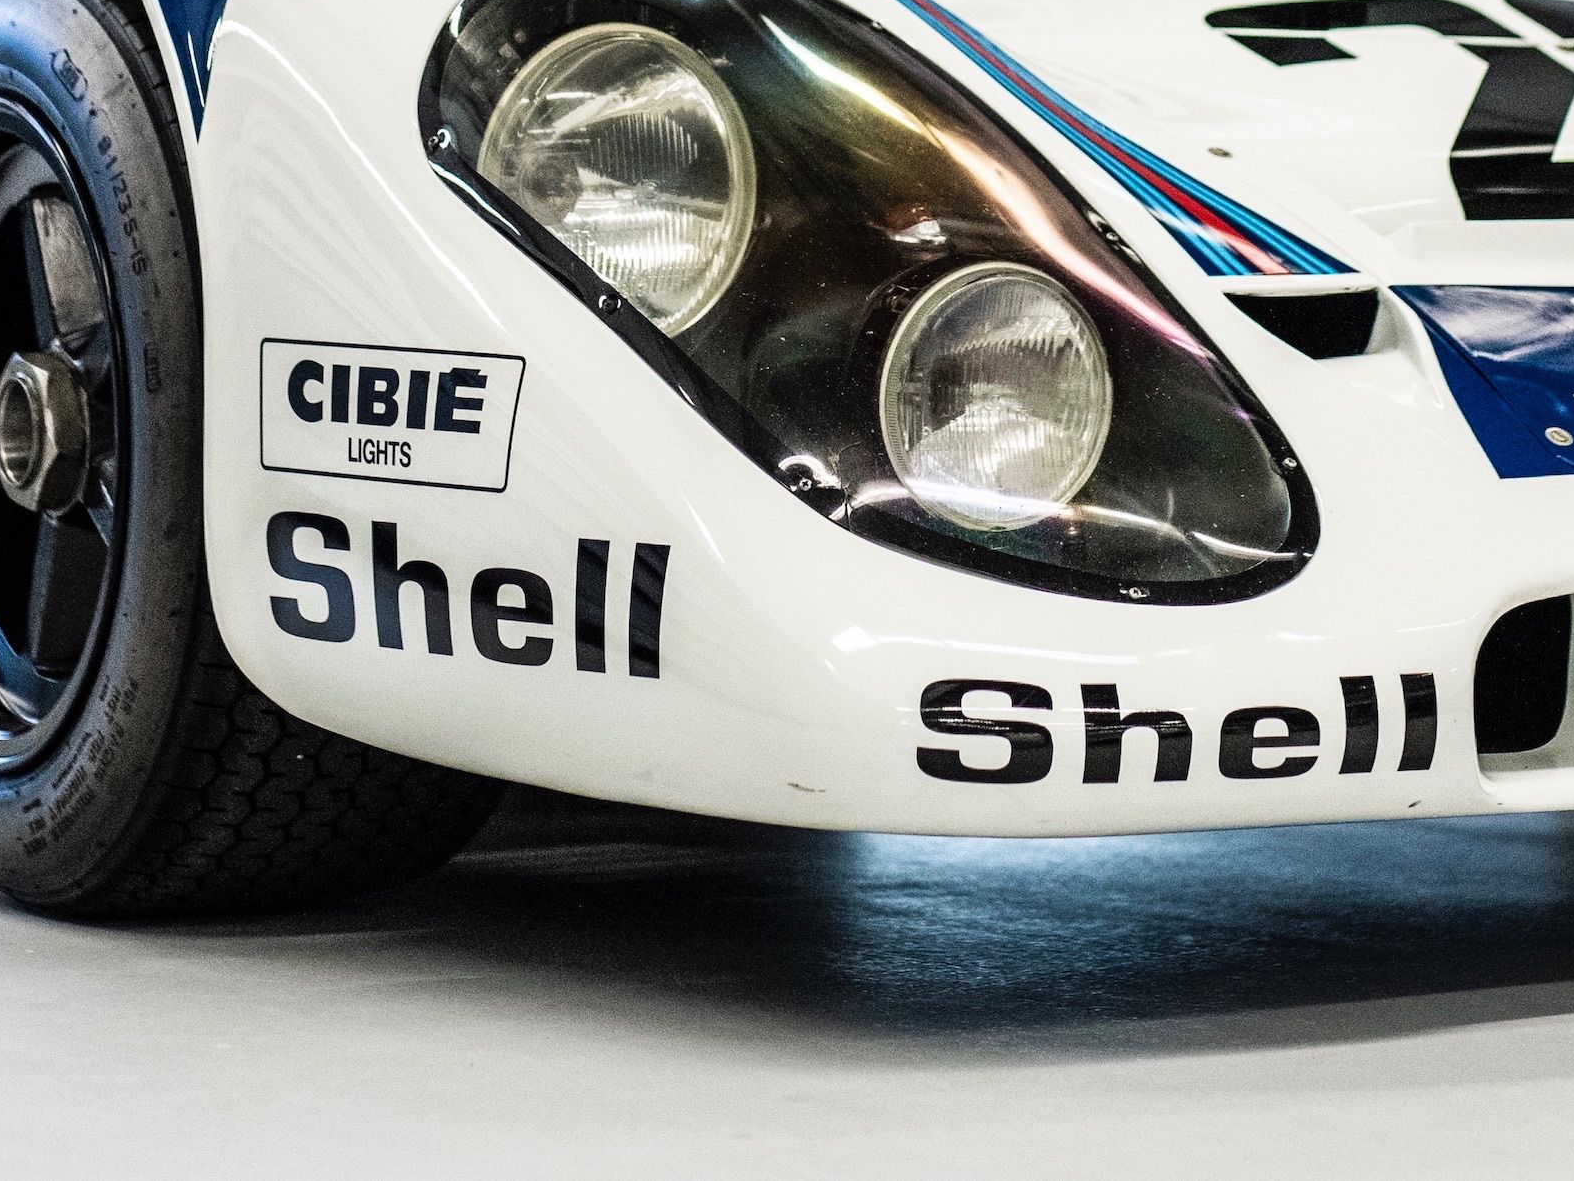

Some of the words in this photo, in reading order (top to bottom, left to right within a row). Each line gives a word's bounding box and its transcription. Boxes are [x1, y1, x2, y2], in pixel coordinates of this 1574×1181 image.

[347, 437, 412, 468] LIGHTS
[266, 511, 671, 679] Shell
[916, 672, 1438, 784] Shell
